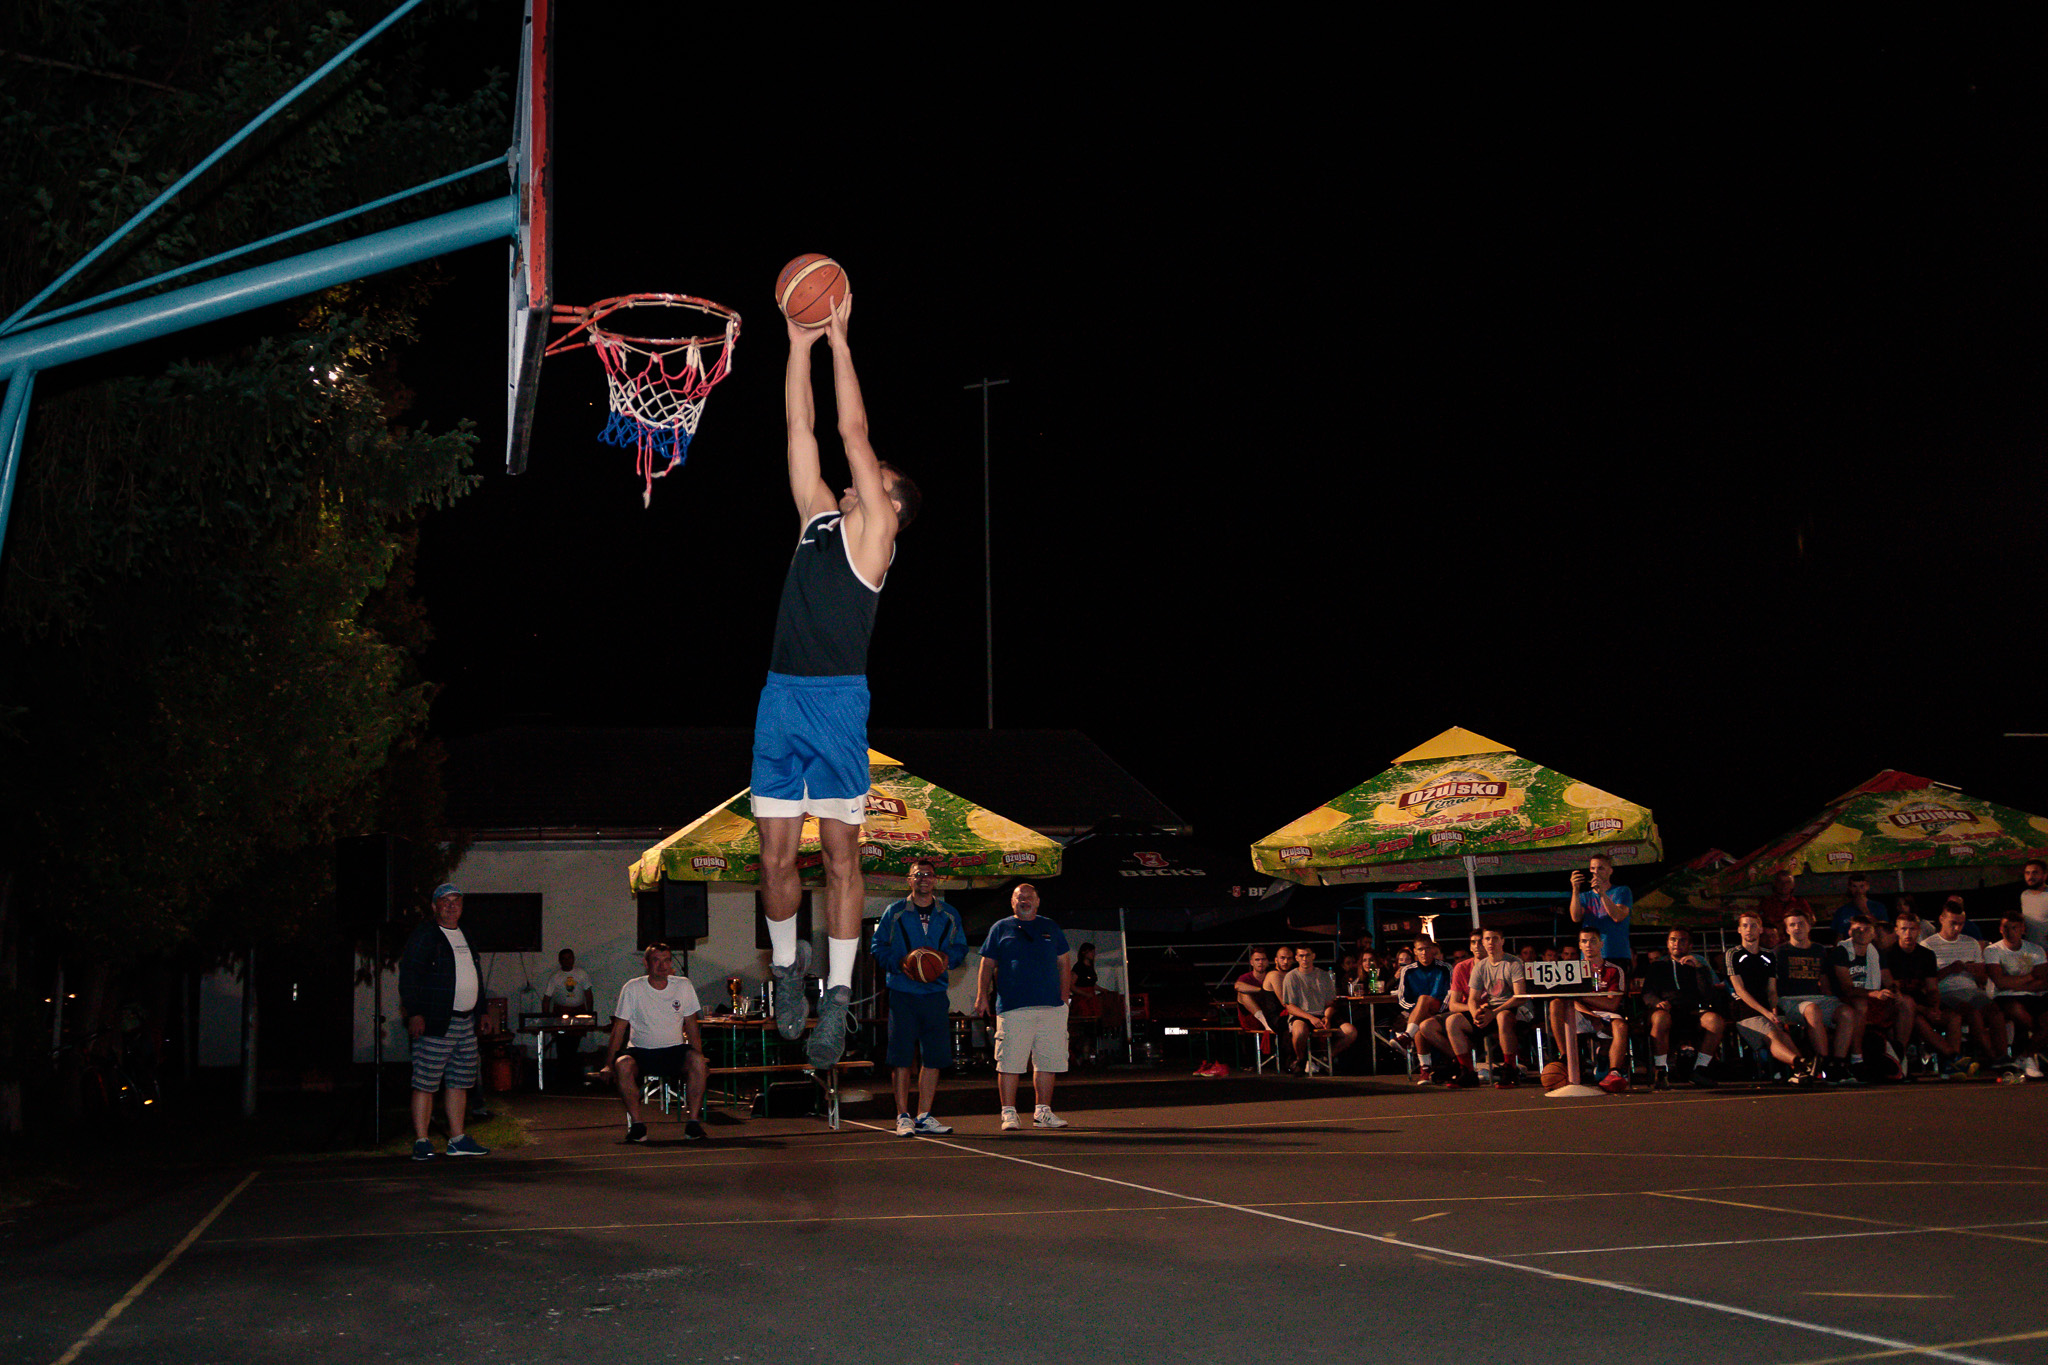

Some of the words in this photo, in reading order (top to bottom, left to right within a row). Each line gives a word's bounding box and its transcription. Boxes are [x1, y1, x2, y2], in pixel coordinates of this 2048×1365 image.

[1407, 782, 1499, 805] Ožujsko
[1527, 966, 1533, 978] 1
[1536, 964, 1553, 982] 15
[1565, 963, 1575, 982] 8
[1583, 964, 1589, 976] 1
